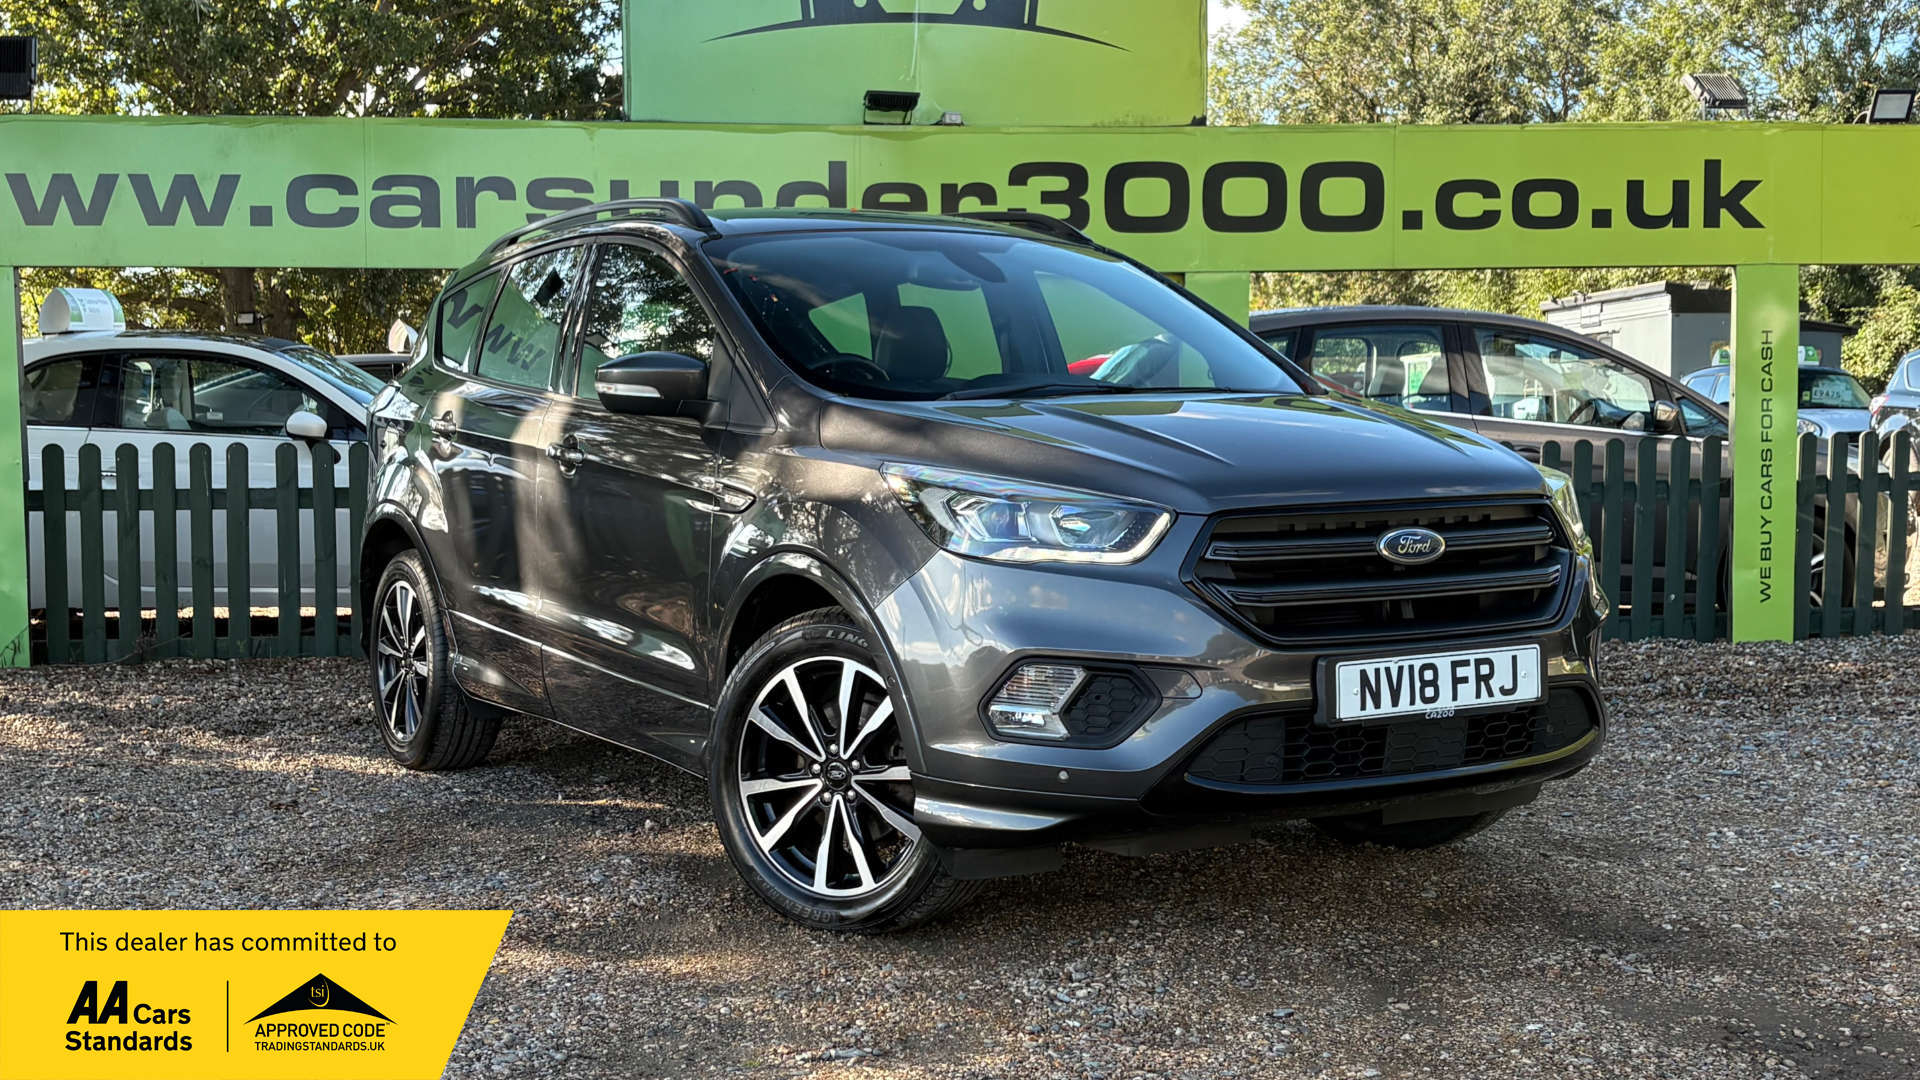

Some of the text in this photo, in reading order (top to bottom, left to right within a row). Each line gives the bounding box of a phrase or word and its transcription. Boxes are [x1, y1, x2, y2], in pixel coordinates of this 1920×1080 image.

[1760, 330, 1773, 603] WE BUY CARS FOR CASH
[1397, 535, 1432, 553] Ford
[1359, 654, 1518, 711] NV18 FRJ
